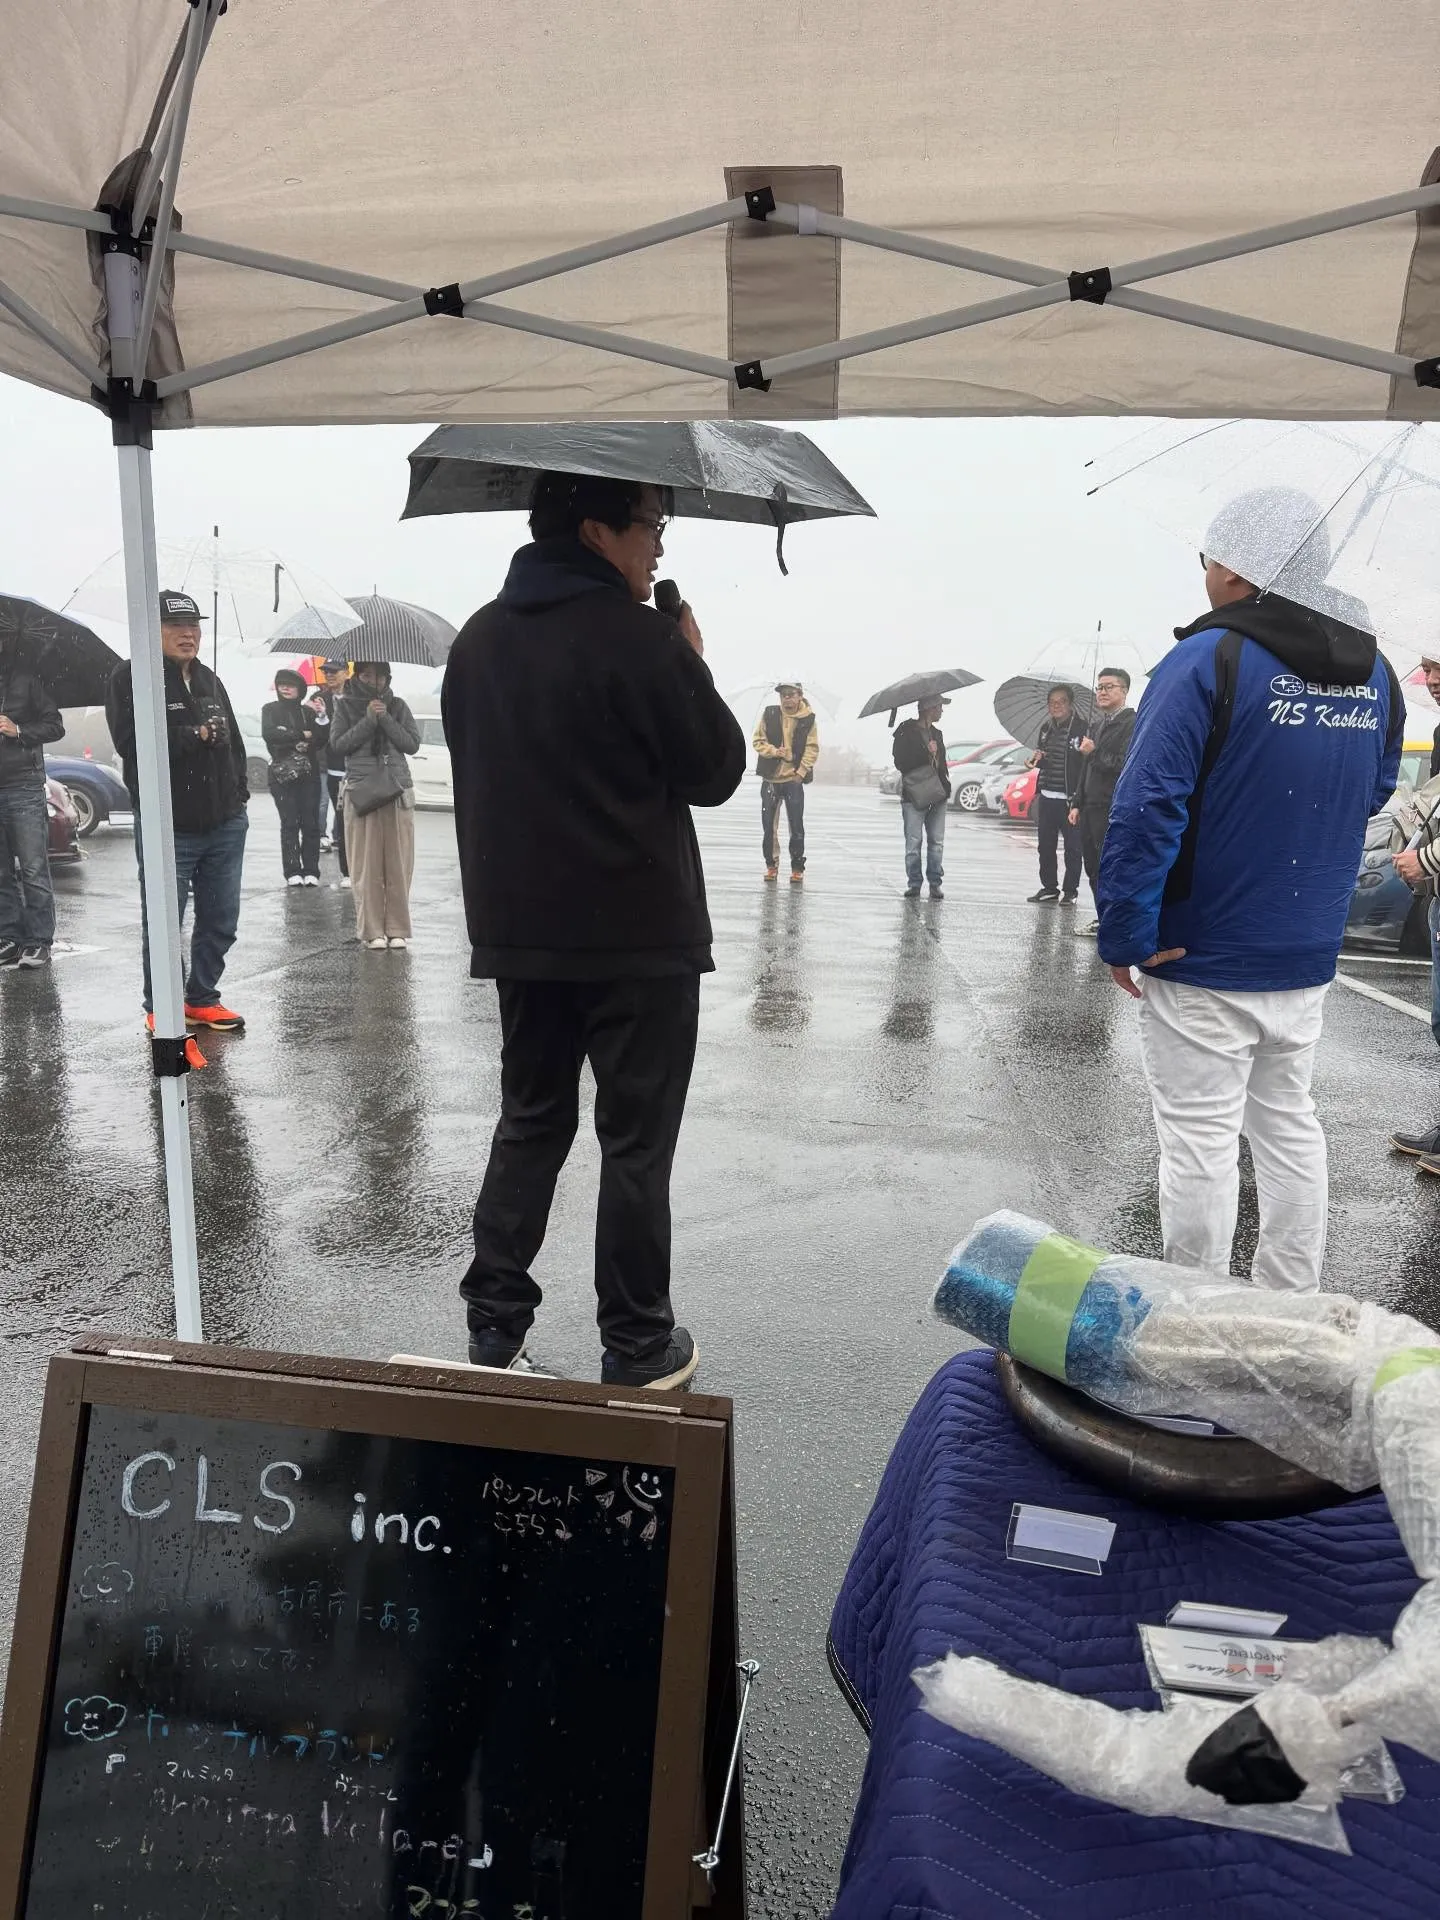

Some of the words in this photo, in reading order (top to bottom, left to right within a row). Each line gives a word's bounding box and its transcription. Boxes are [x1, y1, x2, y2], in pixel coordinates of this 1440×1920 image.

[1306, 682, 1378, 701] SUBARU
[1267, 699, 1308, 725] NS
[1314, 704, 1379, 731] Kashiba
[122, 1450, 302, 1535] CLS
[350, 1492, 452, 1552] inc.
